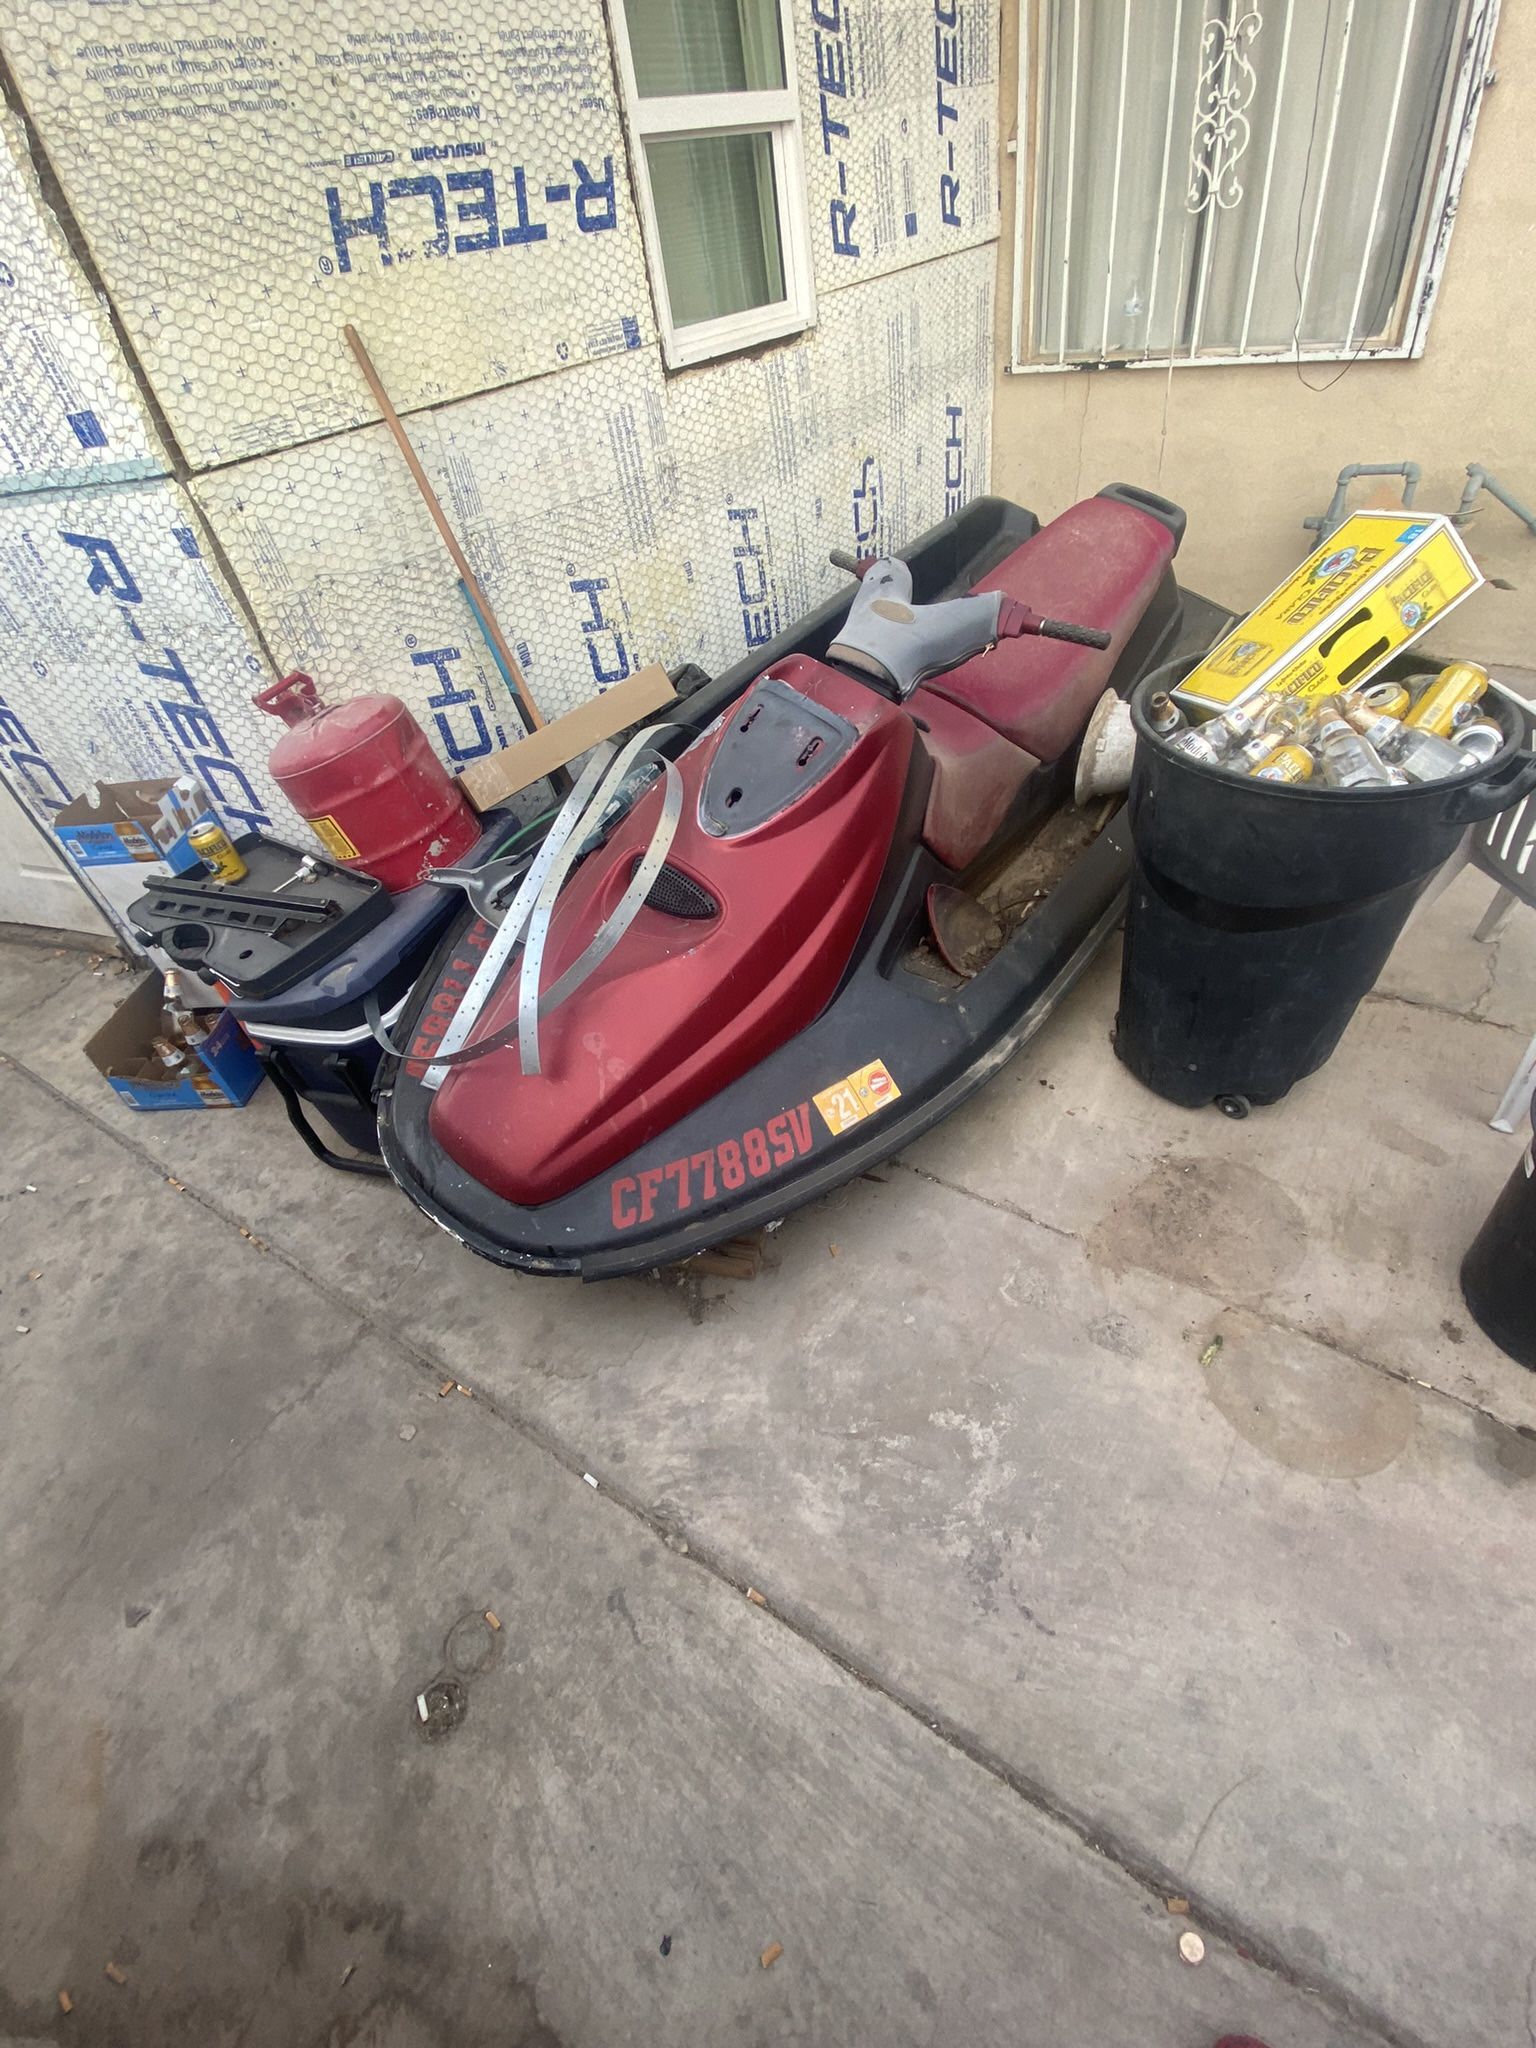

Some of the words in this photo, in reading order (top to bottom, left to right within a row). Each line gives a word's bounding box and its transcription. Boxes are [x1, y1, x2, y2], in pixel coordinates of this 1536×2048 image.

[126, 40, 175, 56] Thermal
[174, 38, 236, 52] Warranted
[146, 60, 169, 74] and
[102, 85, 154, 102] bridging
[202, 81, 226, 94] and
[516, 641, 534, 668] MOLD
[1278, 658, 1327, 699] ACIFICO
[0, 695, 74, 812] EC
[610, 1101, 814, 1231] CF7788SV
